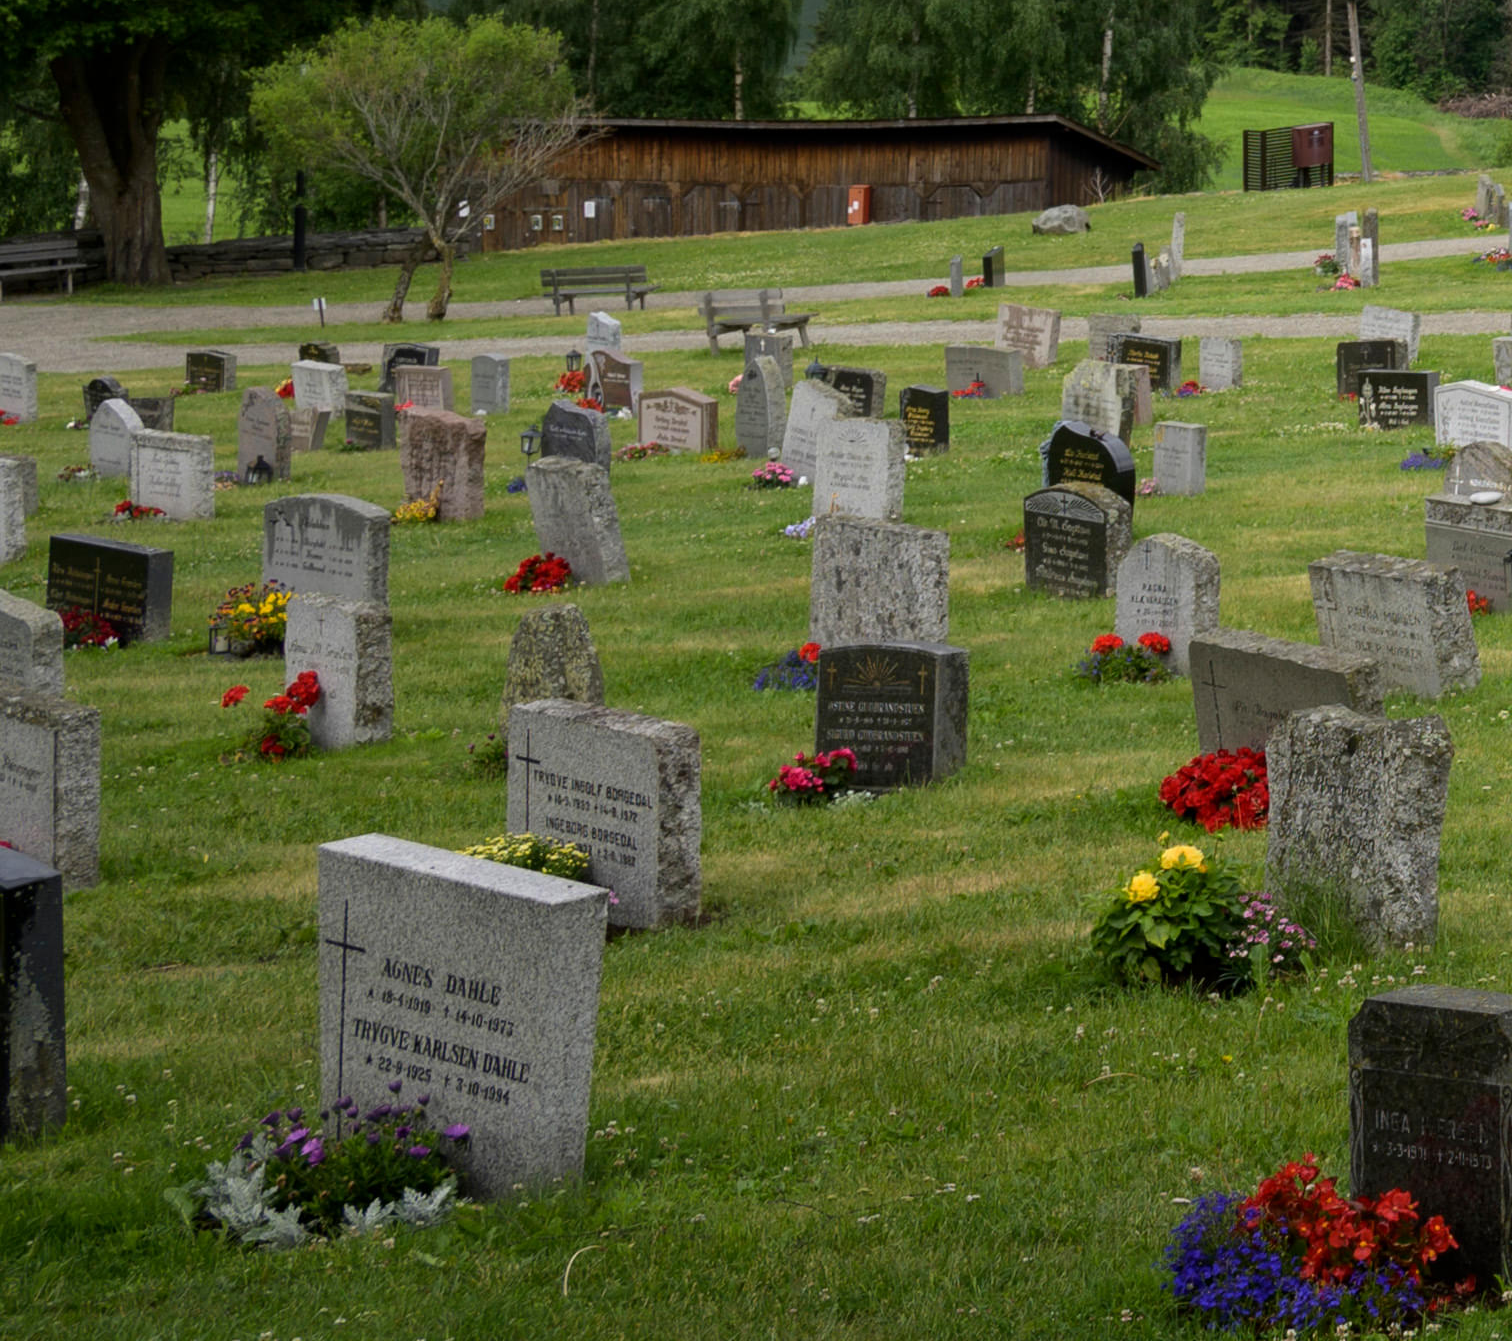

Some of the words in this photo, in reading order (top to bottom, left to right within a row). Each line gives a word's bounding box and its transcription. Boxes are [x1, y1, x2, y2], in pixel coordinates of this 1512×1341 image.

[534, 769, 569, 790] TRYGVE
[605, 785, 654, 810] BORGEDAL
[545, 816, 590, 839] INGEBORG
[591, 826, 638, 852] BORGEDAL
[382, 957, 435, 989] AGNES
[445, 973, 503, 1008] DAHLE
[353, 1017, 411, 1052] TRYGVE
[412, 1033, 480, 1071] KARLSEN
[482, 1052, 532, 1085] DAHLE
[1376, 1109, 1412, 1135] INGA
